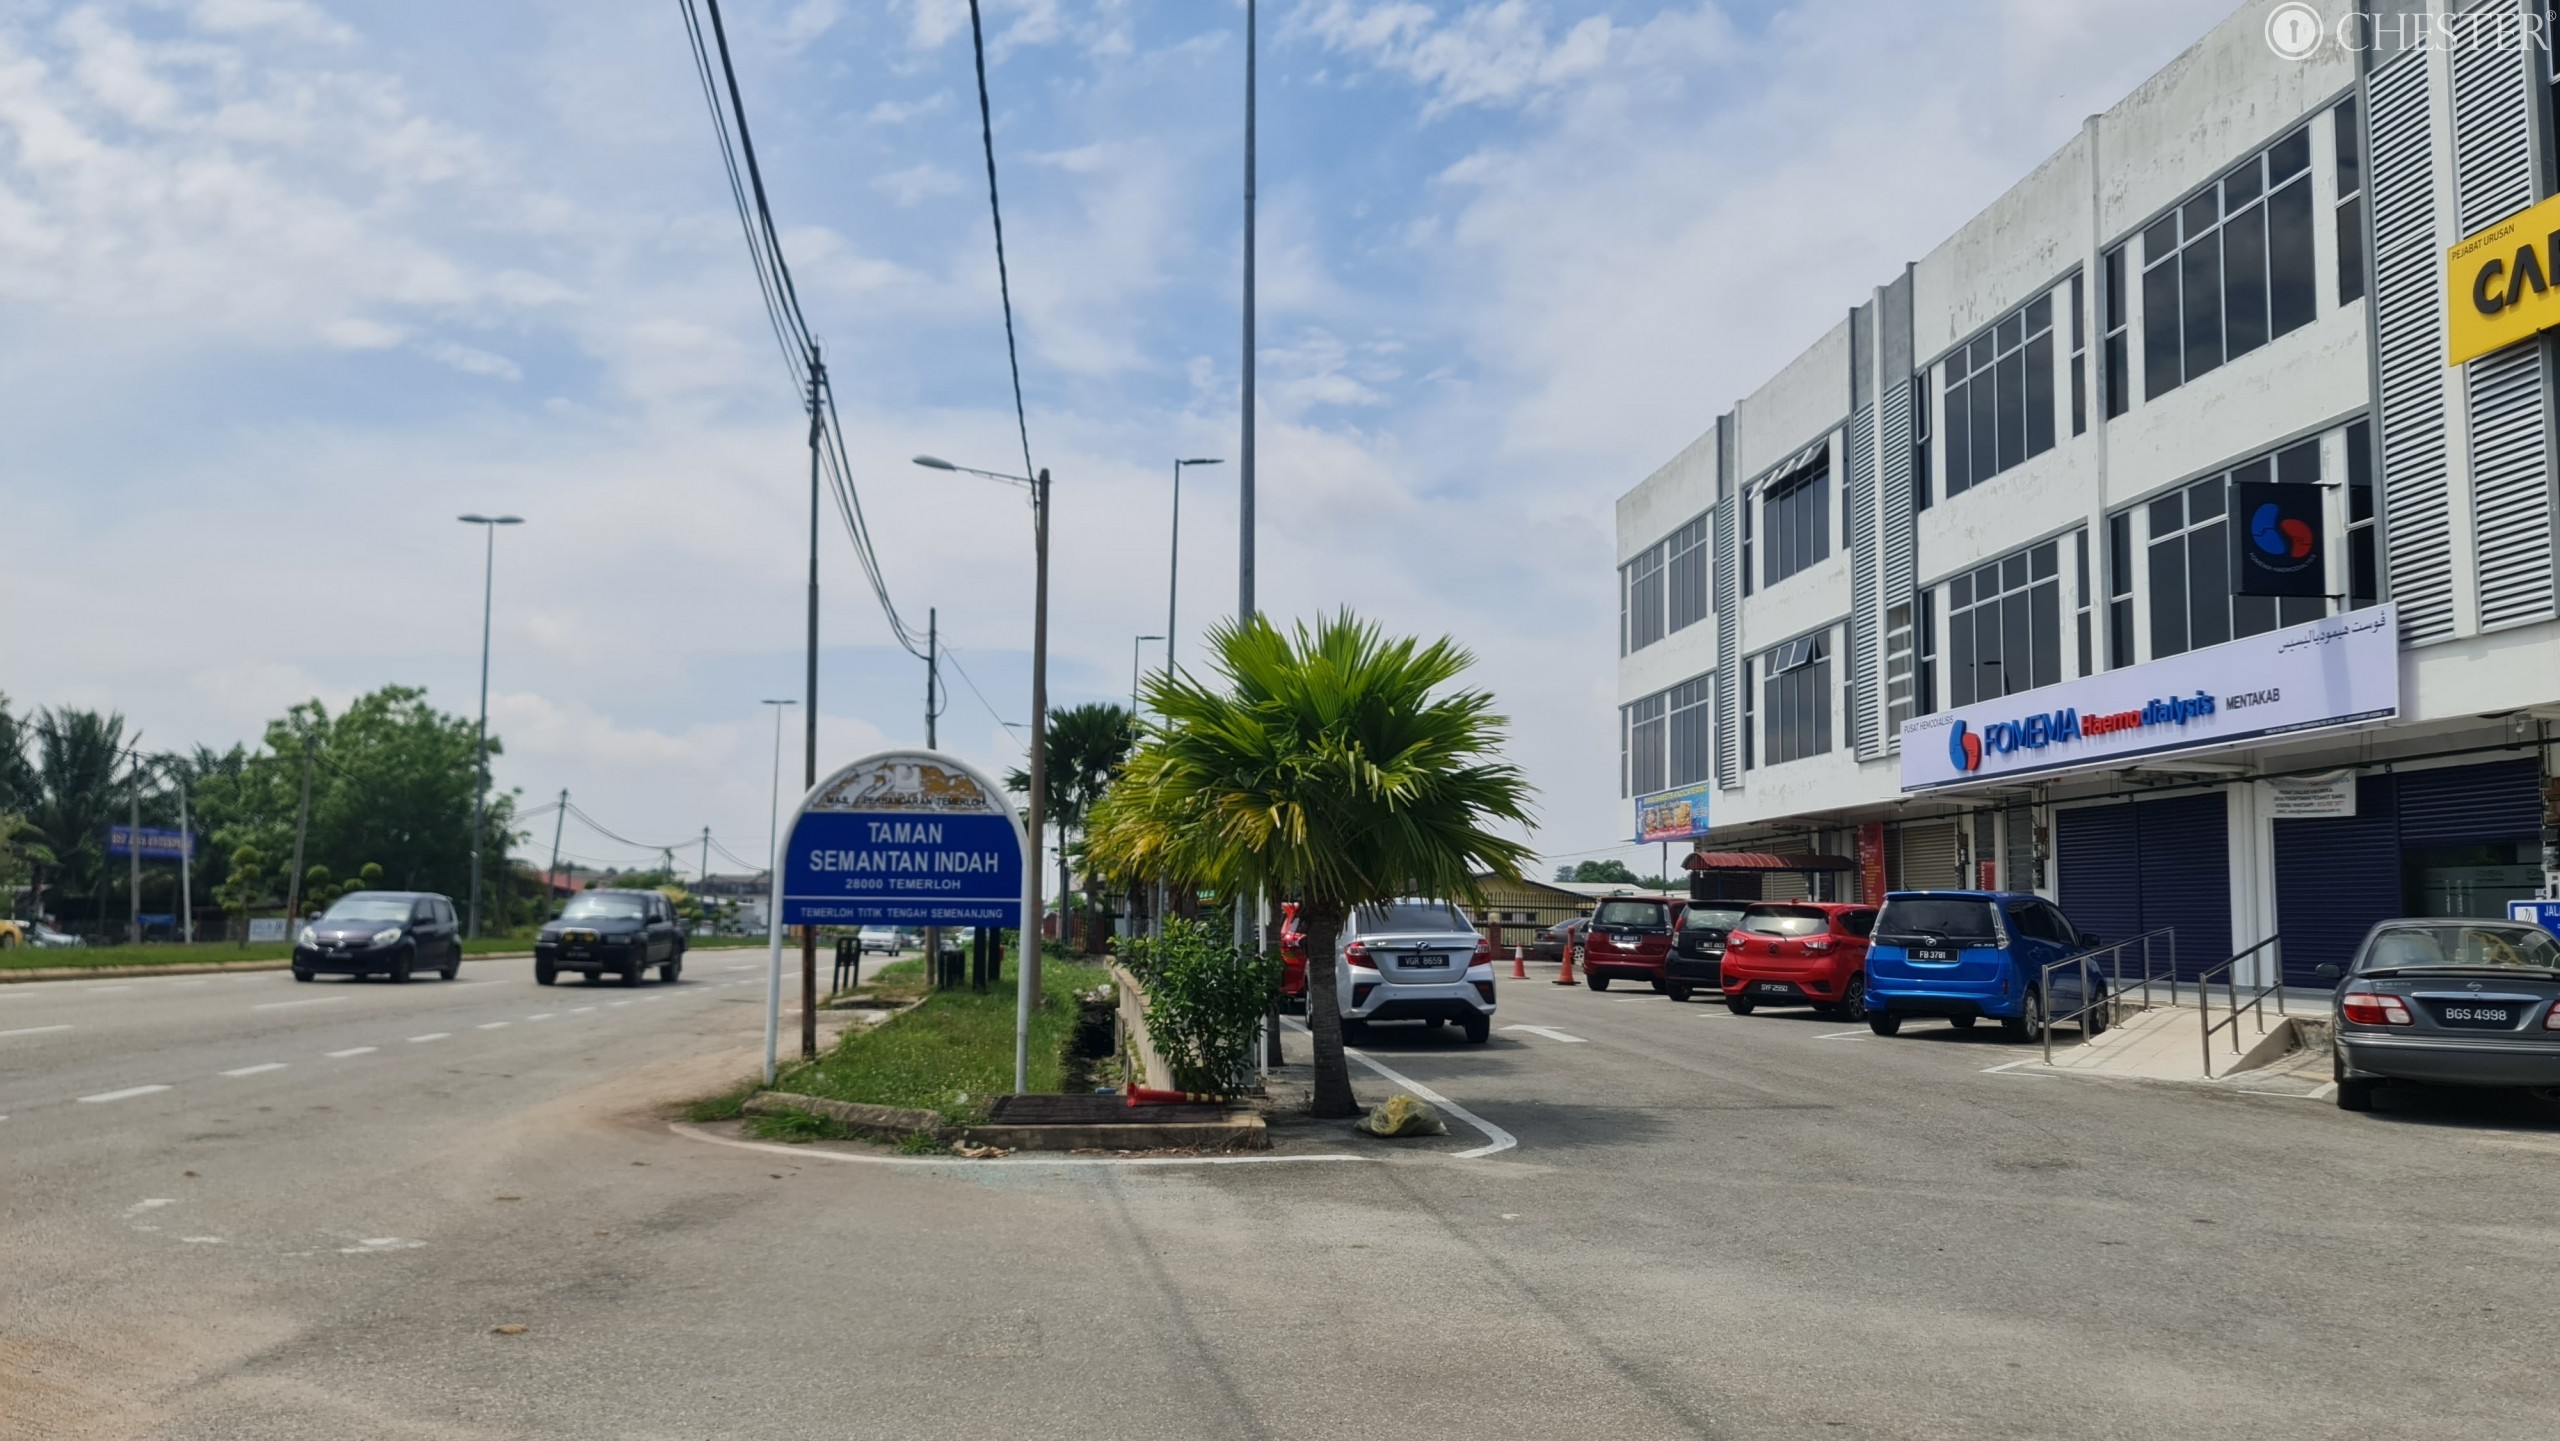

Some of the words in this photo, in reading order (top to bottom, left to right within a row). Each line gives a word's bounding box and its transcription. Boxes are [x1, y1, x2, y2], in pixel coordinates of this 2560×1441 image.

[2451, 239, 2482, 261] PEJABAT
[2483, 223, 2515, 246] URUSAN
[1903, 722, 1919, 734] PUSAT
[1984, 708, 2081, 756] FOMEMA
[2226, 688, 2280, 710] MENTAKAB
[936, 796, 985, 807] TEMERLOH
[868, 822, 942, 844] TAMAN
[809, 850, 928, 872] SEMANTAN
[934, 852, 999, 873] INDAH
[845, 878, 883, 890] 28000
[889, 879, 961, 890] TEMERLOH
[801, 907, 854, 918] TEMERLOH
[858, 907, 882, 918] TITIK
[887, 908, 927, 918] TENGAH
[931, 908, 1003, 919] SEMENANJUNG
[1405, 957, 1420, 965] VGR
[1422, 956, 1443, 965] 8659
[1919, 950, 1929, 959] FB
[1930, 951, 1946, 959] 3781
[2446, 1008, 2471, 1020] BGS
[2474, 1009, 2507, 1021] 4998
